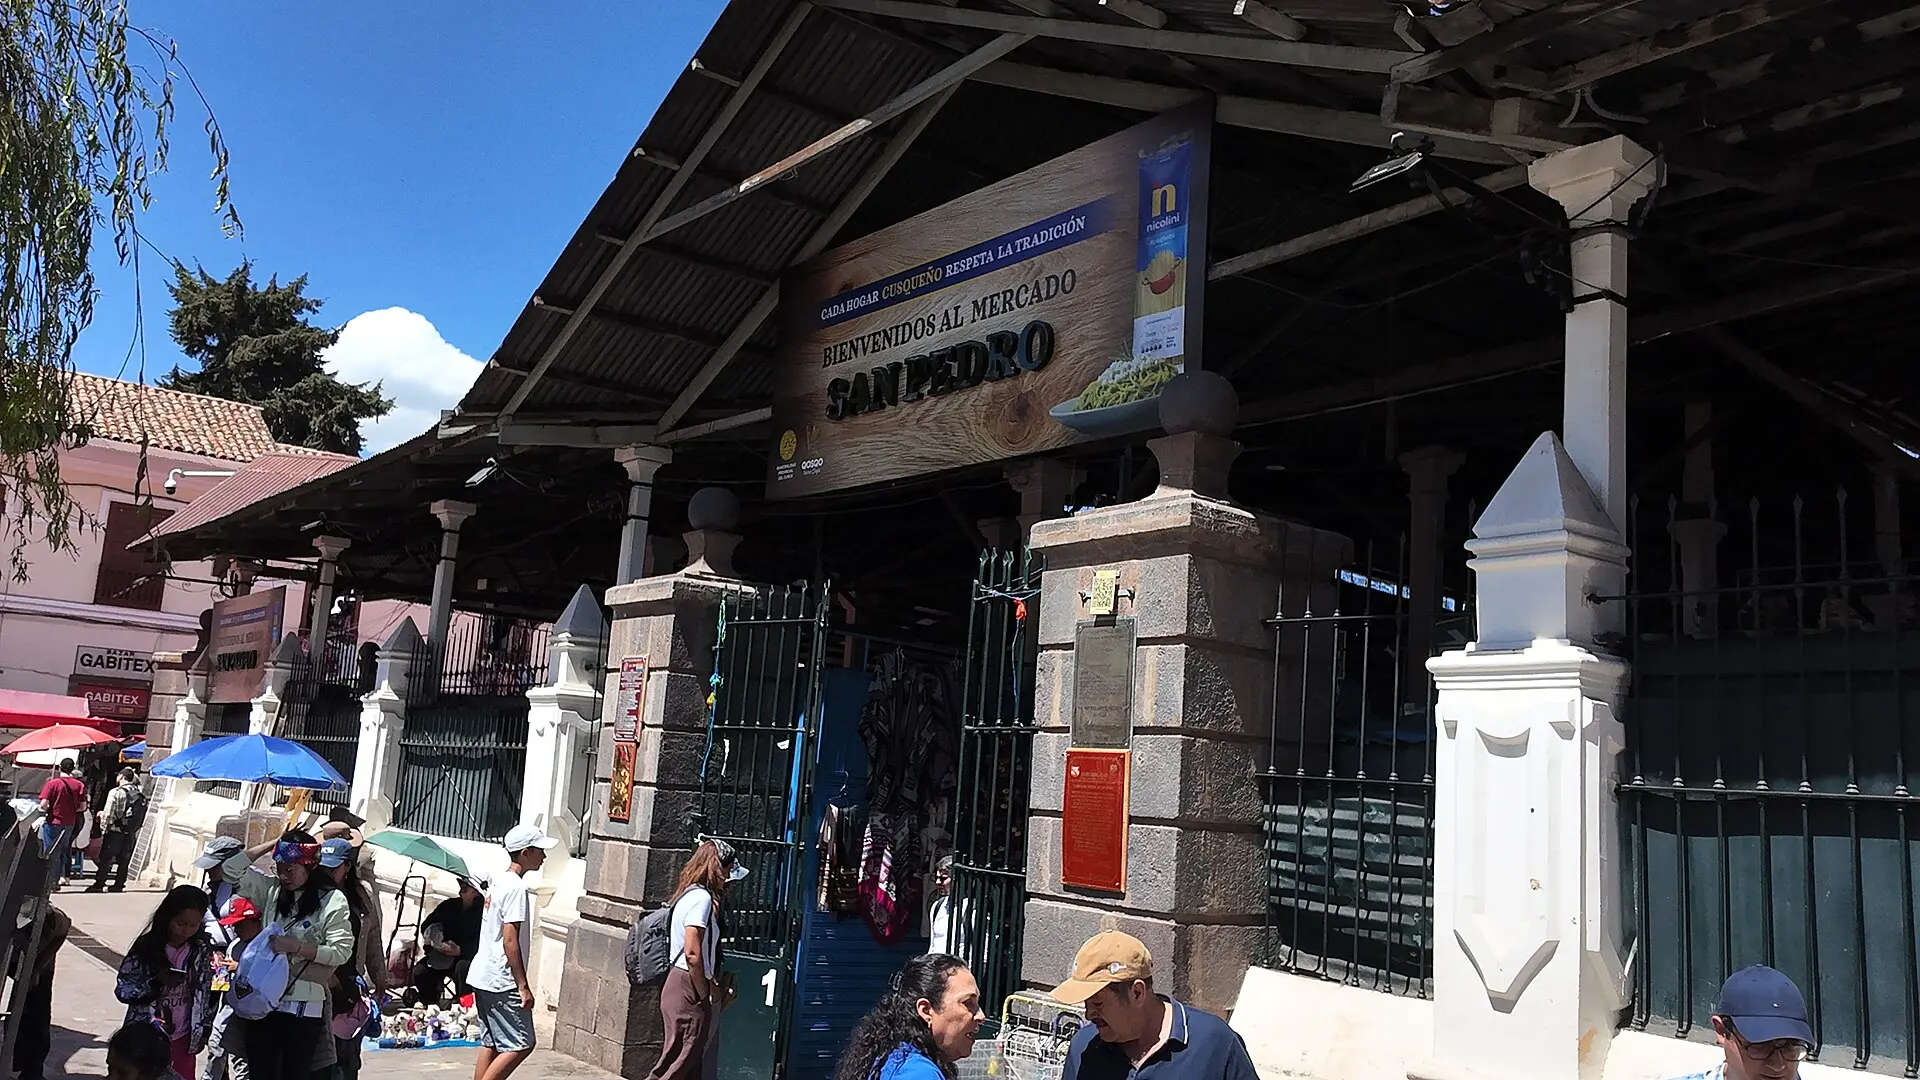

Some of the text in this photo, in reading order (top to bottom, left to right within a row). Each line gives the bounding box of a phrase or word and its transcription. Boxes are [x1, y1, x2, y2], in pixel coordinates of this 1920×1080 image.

[1146, 212, 1180, 233] nicolini
[821, 215, 1086, 320] CADA HOGAR CUSQUEÑO RESPETA LA TRADICIÓN
[822, 268, 1077, 369] BIENVENIDOS AL MERCADO
[825, 319, 1055, 421] SAN PEDRO
[80, 653, 155, 674] GABITEX
[106, 649, 135, 657] BAZAR
[84, 691, 139, 705] GABITEX
[761, 968, 777, 1007] 1
